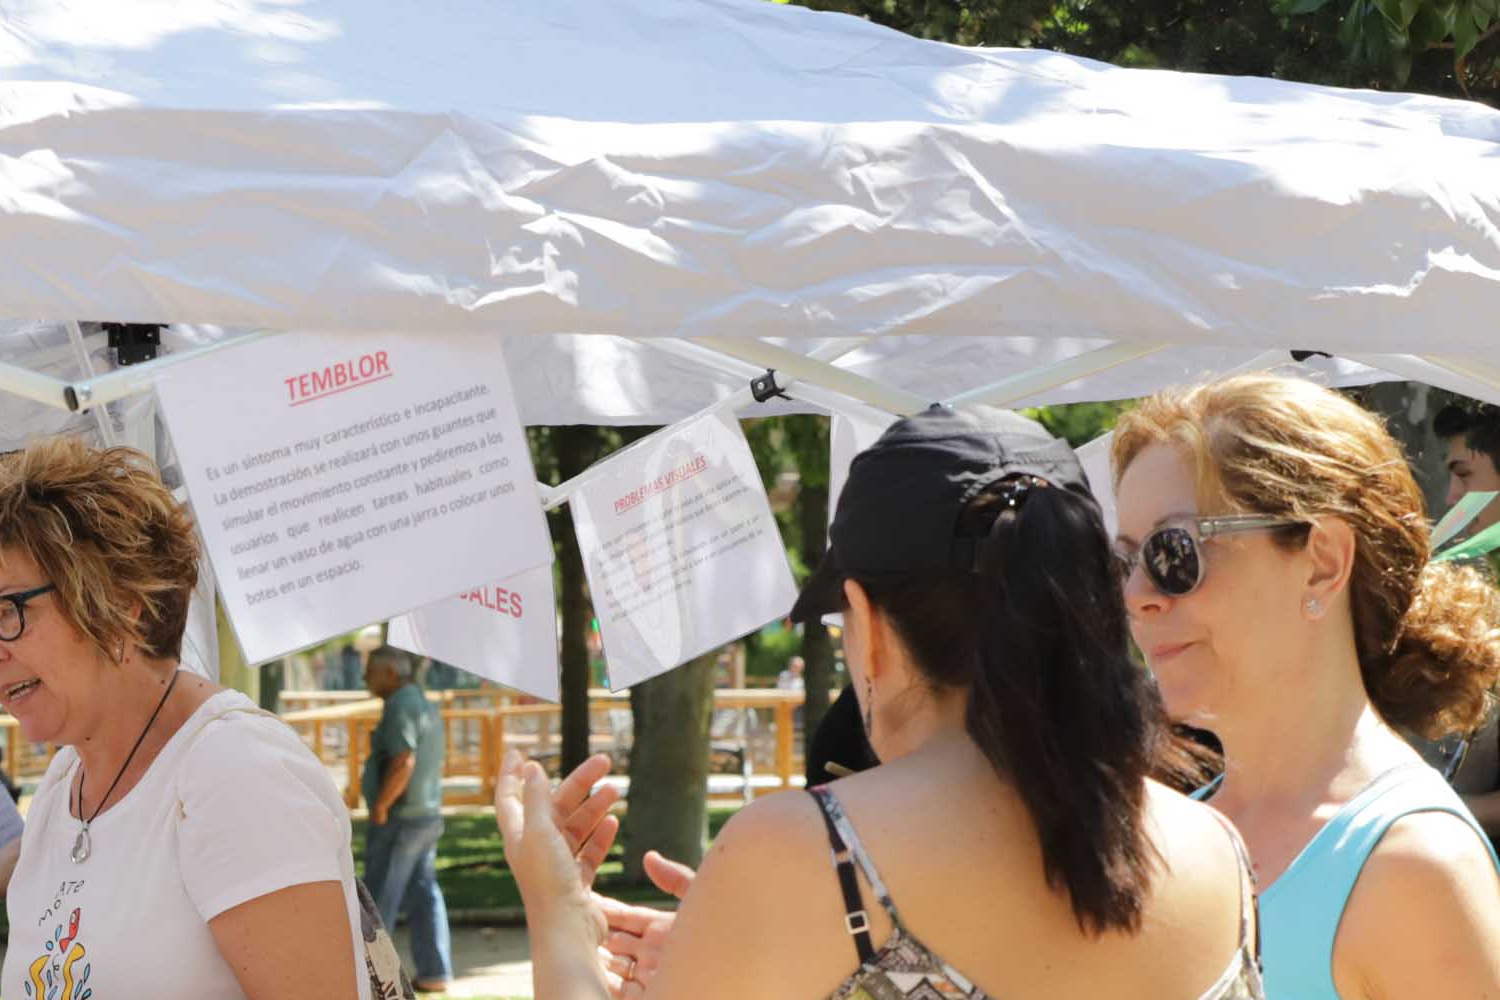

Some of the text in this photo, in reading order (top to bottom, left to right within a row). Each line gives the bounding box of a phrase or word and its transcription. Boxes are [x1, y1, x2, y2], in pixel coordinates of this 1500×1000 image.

[284, 351, 391, 400] TEMBLOR
[205, 384, 490, 481] Es un síntoma muy característico e incapacitante.
[214, 407, 497, 507] La demostración se realizará con unos guantes que
[222, 431, 503, 531] simular el movimiento constante y pediremos a los
[230, 456, 509, 555] usuarios que realicen tareas habituales como
[237, 481, 515, 581] llenar un vaso de agua con una jarra o colocar unos
[245, 559, 364, 606] botes en un espacio.
[460, 585, 523, 618] ALES
